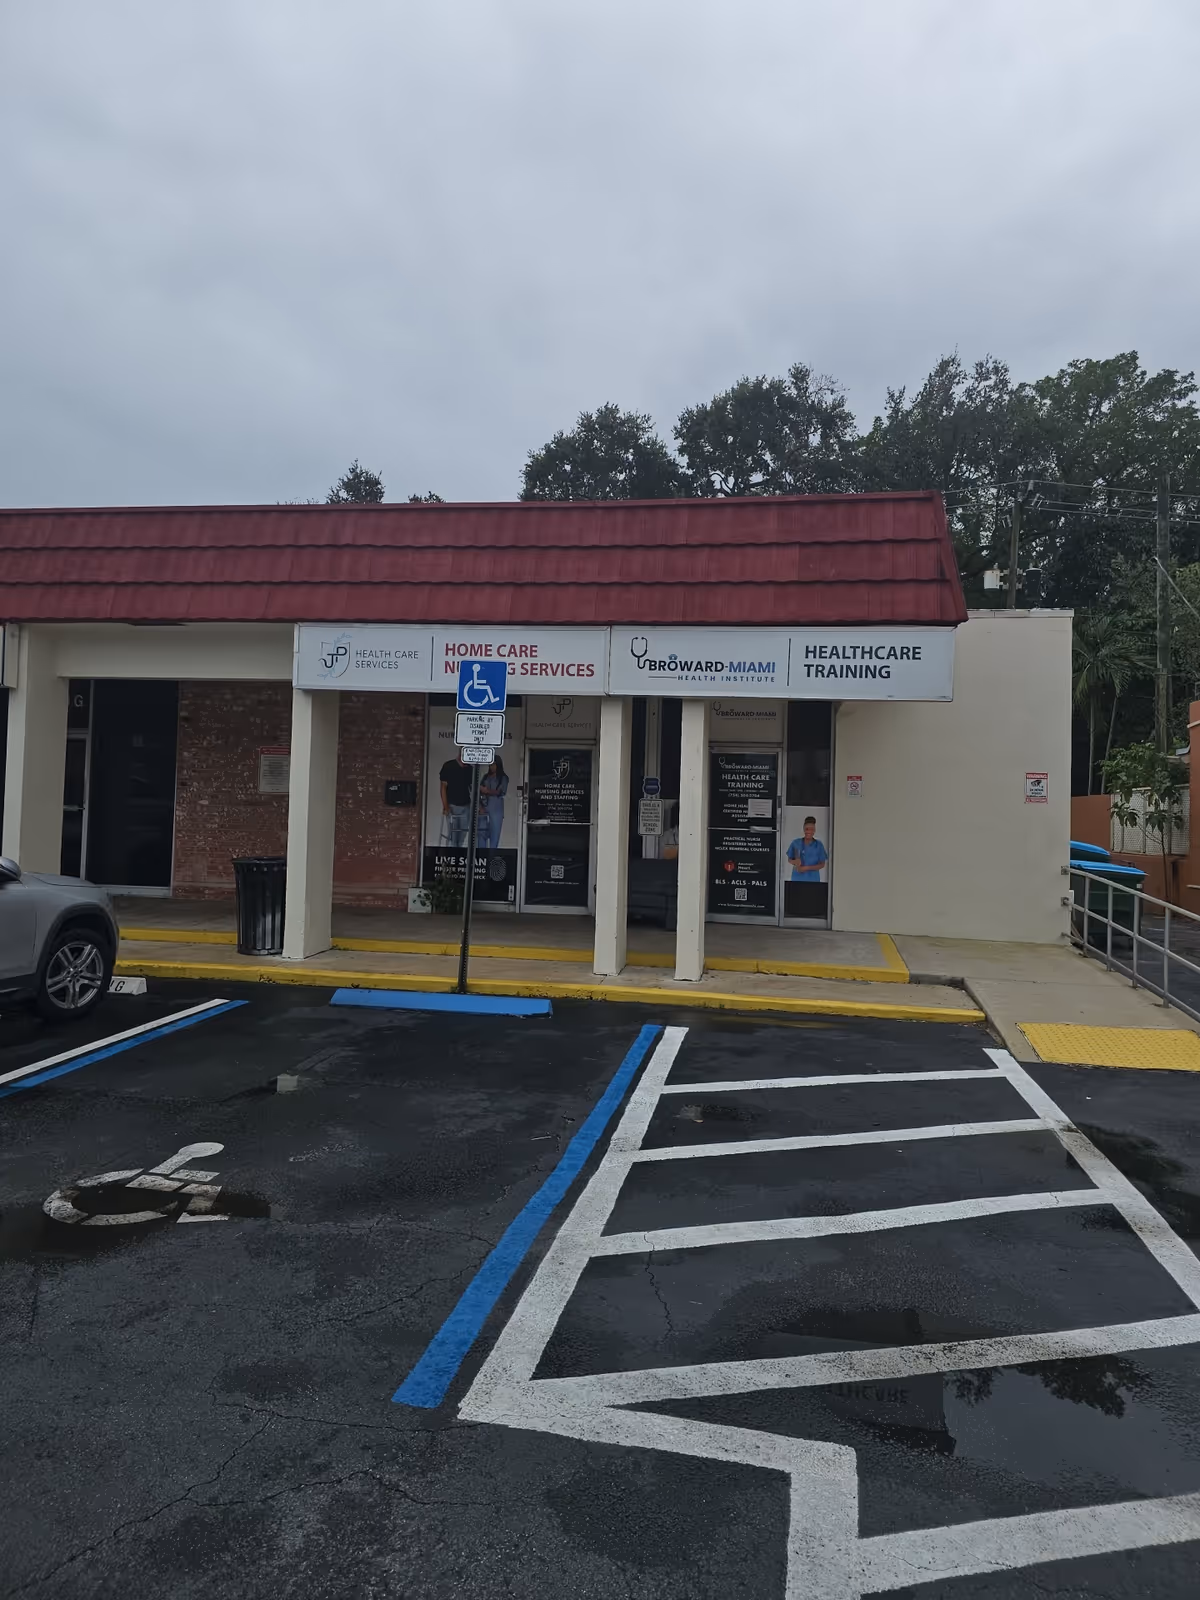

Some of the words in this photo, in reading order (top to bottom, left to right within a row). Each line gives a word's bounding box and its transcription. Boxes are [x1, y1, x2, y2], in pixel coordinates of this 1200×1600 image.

[355, 649, 392, 660] HEALTH
[394, 650, 419, 660] CARE
[445, 643, 493, 657] HOME
[496, 644, 538, 658] CARE
[805, 645, 922, 661] HEALTHCARE
[354, 660, 400, 670] SERVICES
[520, 662, 595, 678] SERVICES
[649, 660, 776, 674] BROWARD-MIAMI
[803, 664, 891, 679] TRAINING
[73, 694, 83, 707] G
[435, 856, 456, 865] LIVE
